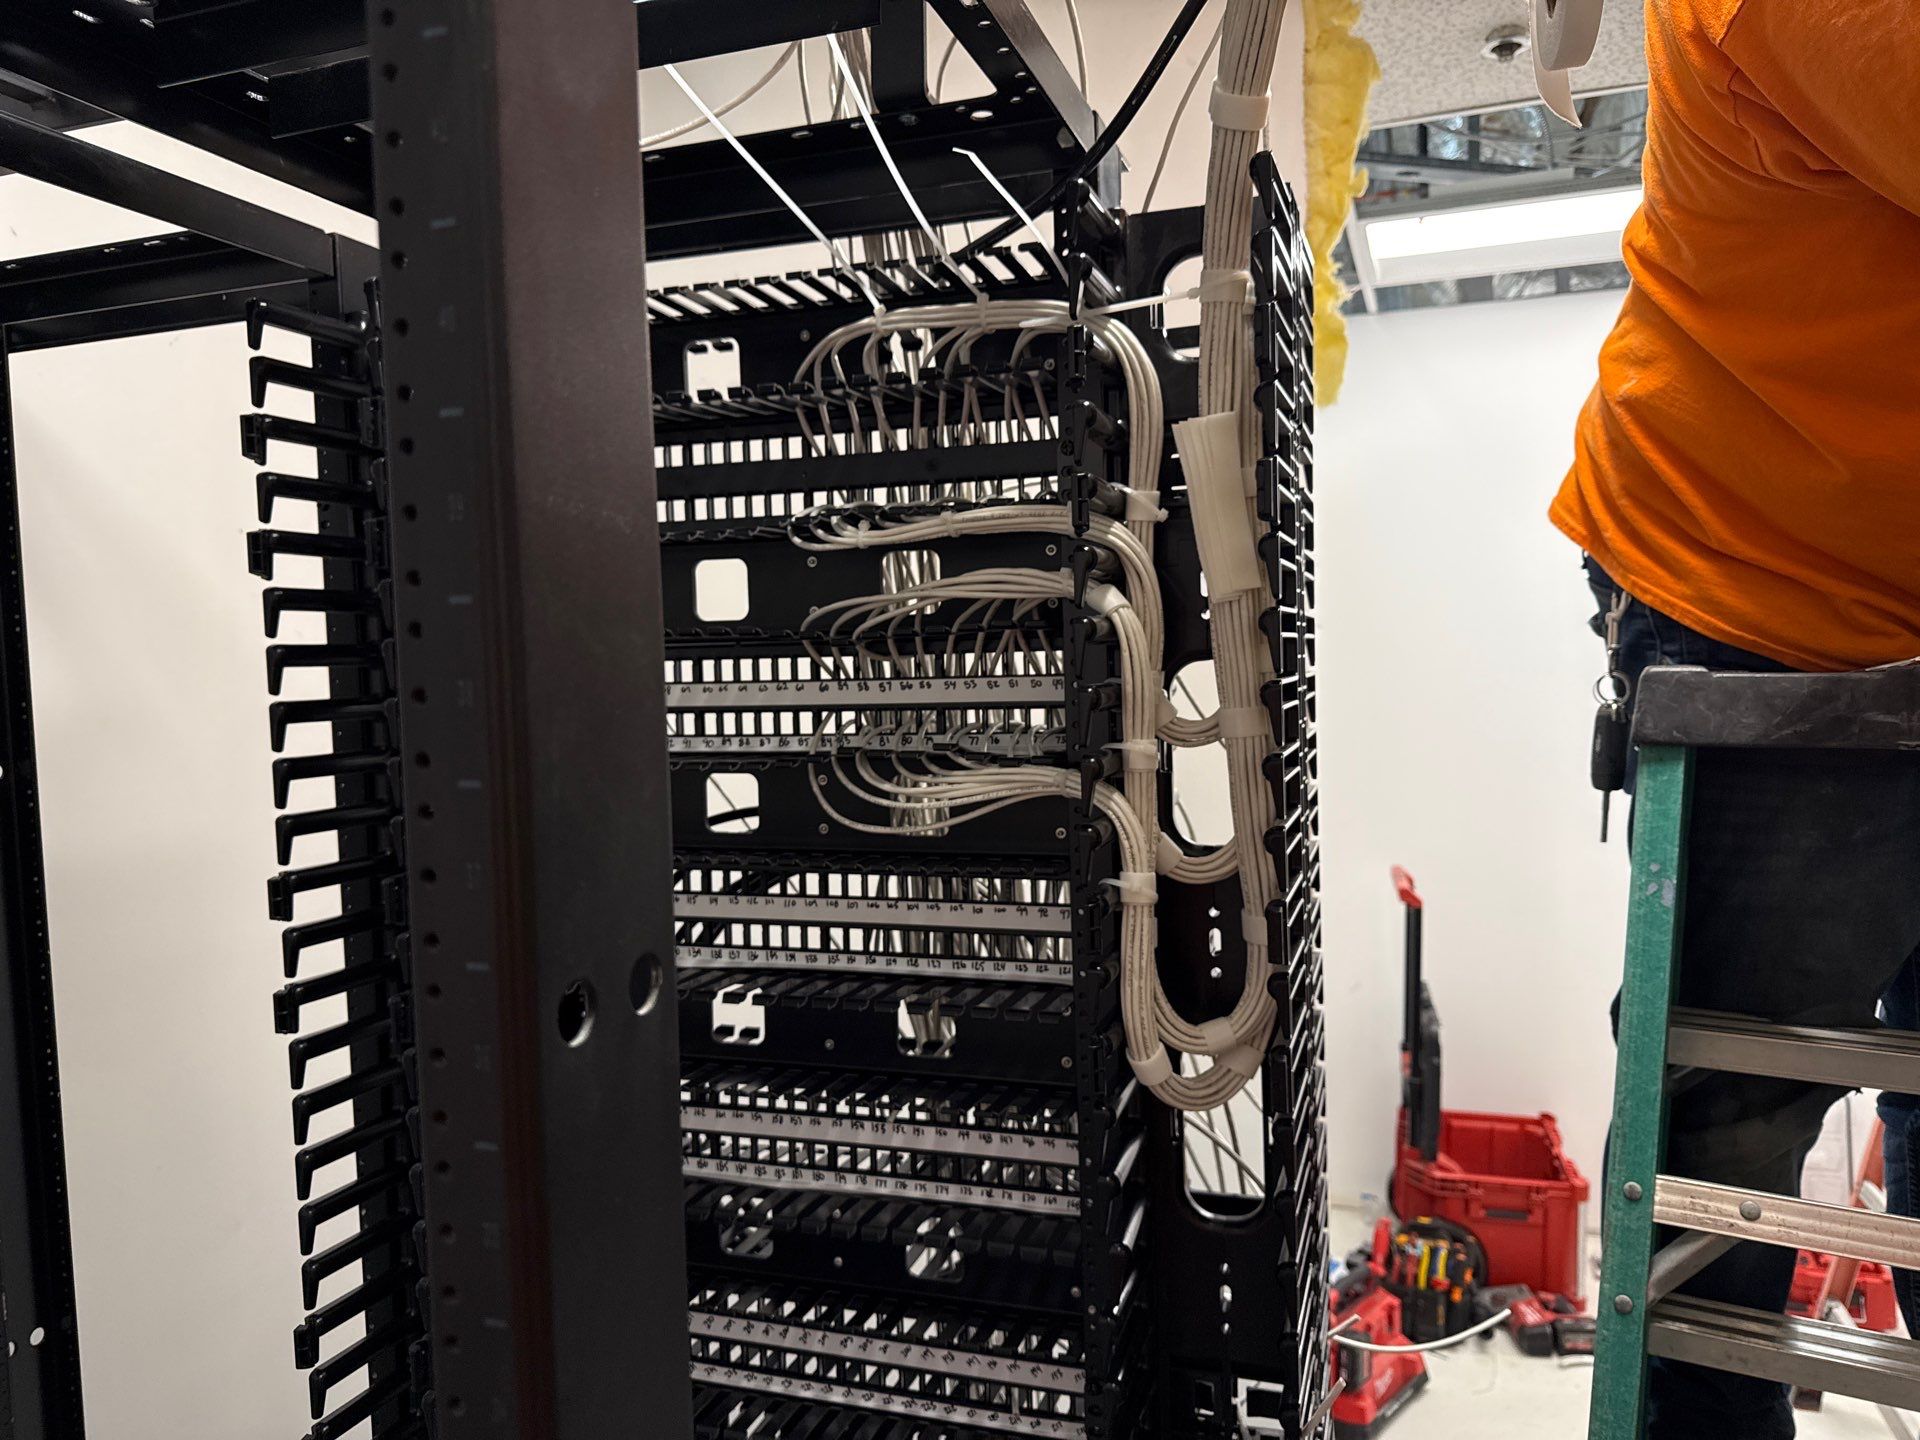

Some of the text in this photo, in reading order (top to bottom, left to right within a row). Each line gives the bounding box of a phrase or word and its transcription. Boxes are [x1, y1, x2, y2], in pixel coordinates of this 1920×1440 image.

[680, 685, 691, 693] 67
[719, 684, 728, 692] 65
[738, 684, 748, 692] 64
[838, 682, 849, 690] 59
[857, 682, 869, 692] 58
[879, 682, 892, 692] 57
[900, 682, 913, 691] 56
[919, 681, 931, 689] 55
[944, 681, 956, 690] 54
[964, 680, 977, 689] 53
[987, 680, 1000, 689] 52
[1008, 679, 1019, 688] 51
[1030, 679, 1042, 688] 50
[1052, 678, 1064, 689] 49
[683, 738, 692, 748] 91
[702, 738, 715, 747] 90
[722, 737, 732, 746] 89
[759, 737, 770, 747] 87
[779, 737, 790, 747] 86
[798, 736, 810, 746] 85
[821, 736, 832, 747] 84
[879, 736, 890, 747] 81
[901, 736, 912, 745] 80
